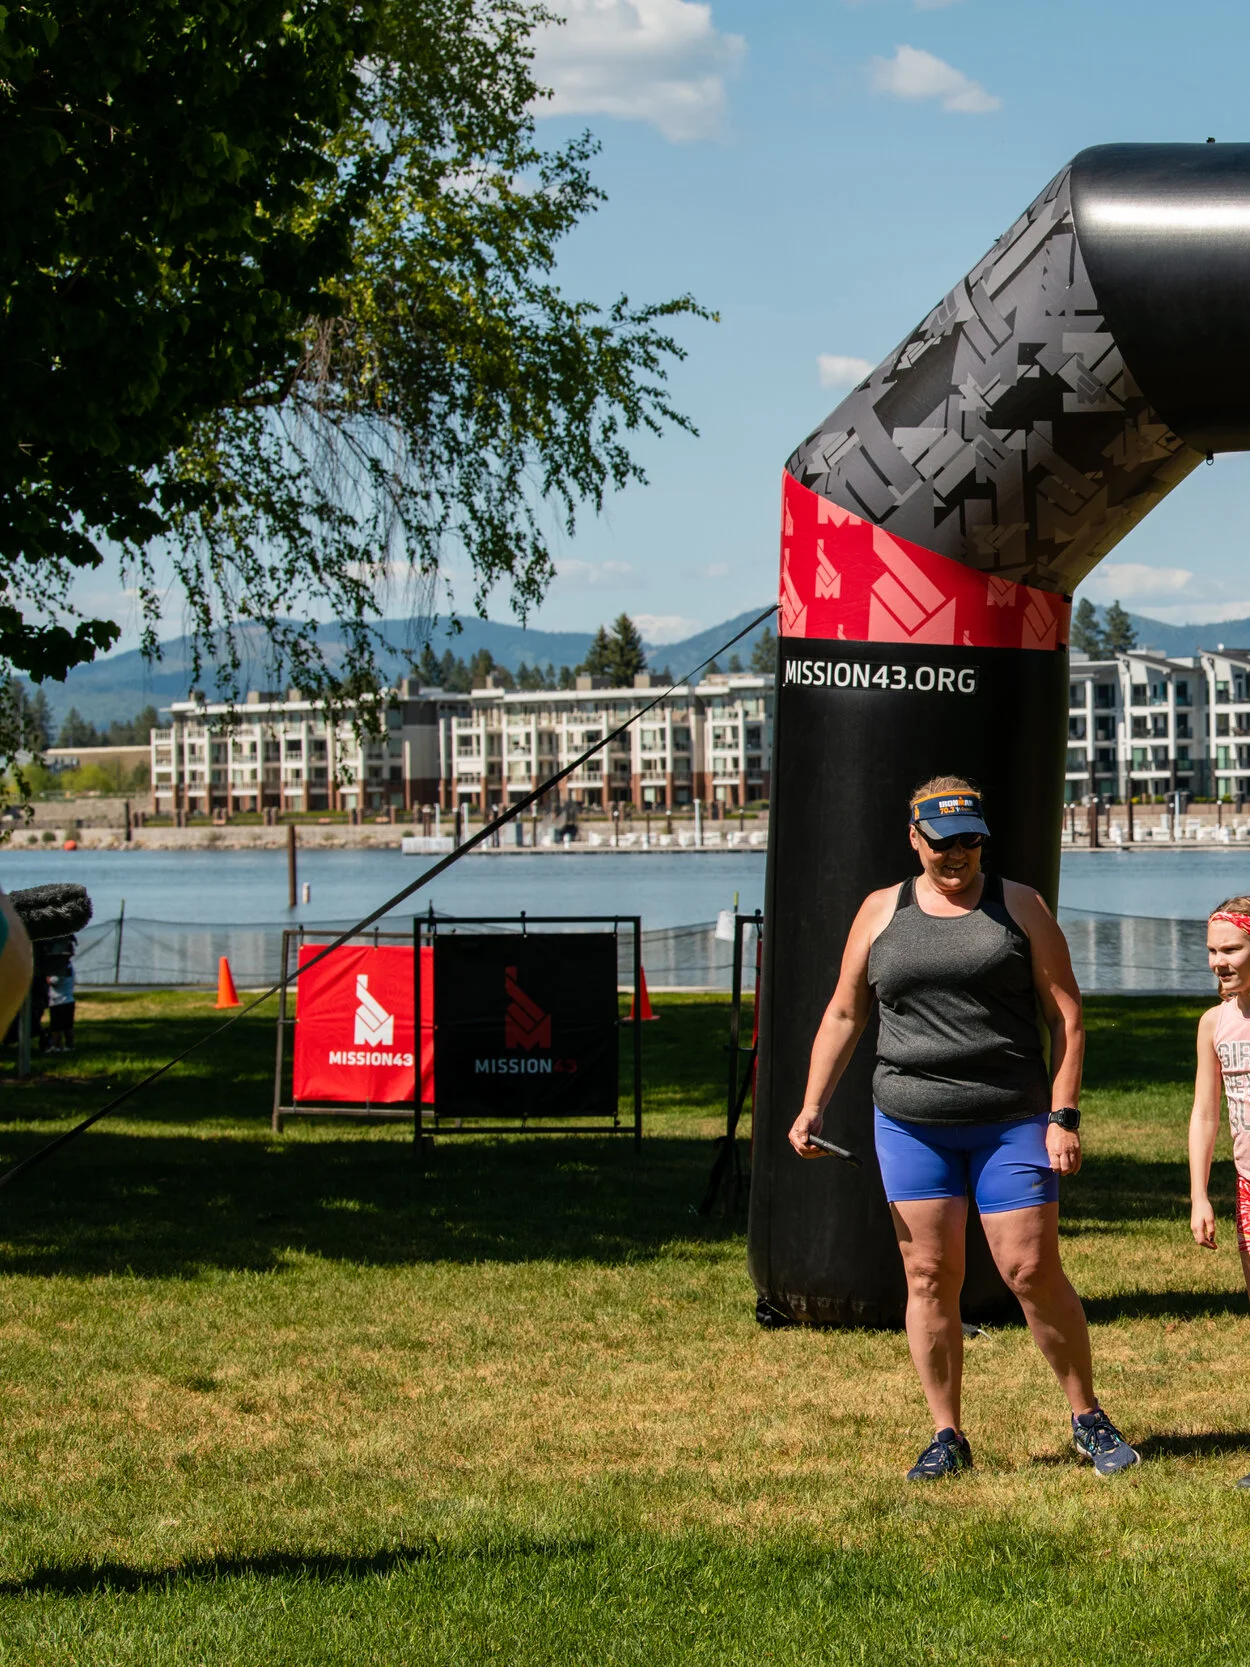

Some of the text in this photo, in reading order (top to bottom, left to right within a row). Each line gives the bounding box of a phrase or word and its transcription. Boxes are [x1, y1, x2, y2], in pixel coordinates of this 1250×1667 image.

[784, 659, 976, 693] MISSION43.ORG
[329, 1051, 414, 1068] MISSION43
[475, 1059, 578, 1074] MISSION43
